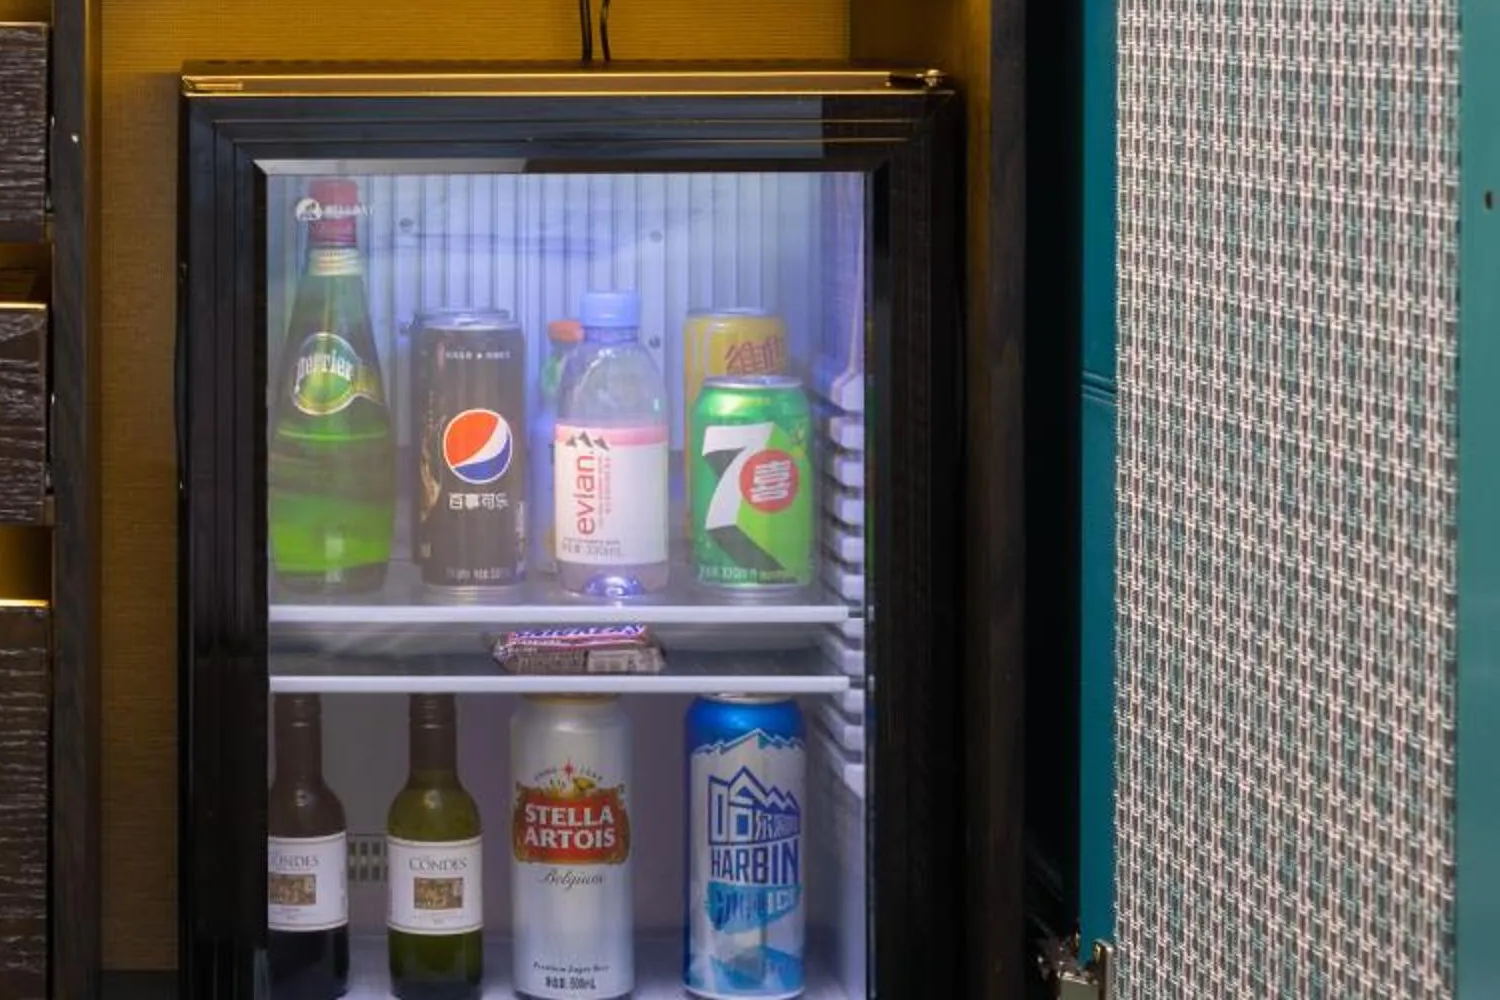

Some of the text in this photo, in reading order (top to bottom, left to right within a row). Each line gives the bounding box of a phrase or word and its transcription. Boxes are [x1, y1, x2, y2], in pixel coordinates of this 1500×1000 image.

[573, 455, 596, 535] evian
[525, 802, 615, 827] STELLA
[525, 826, 617, 850] ARTOIS
[710, 838, 800, 885] HARBIN
